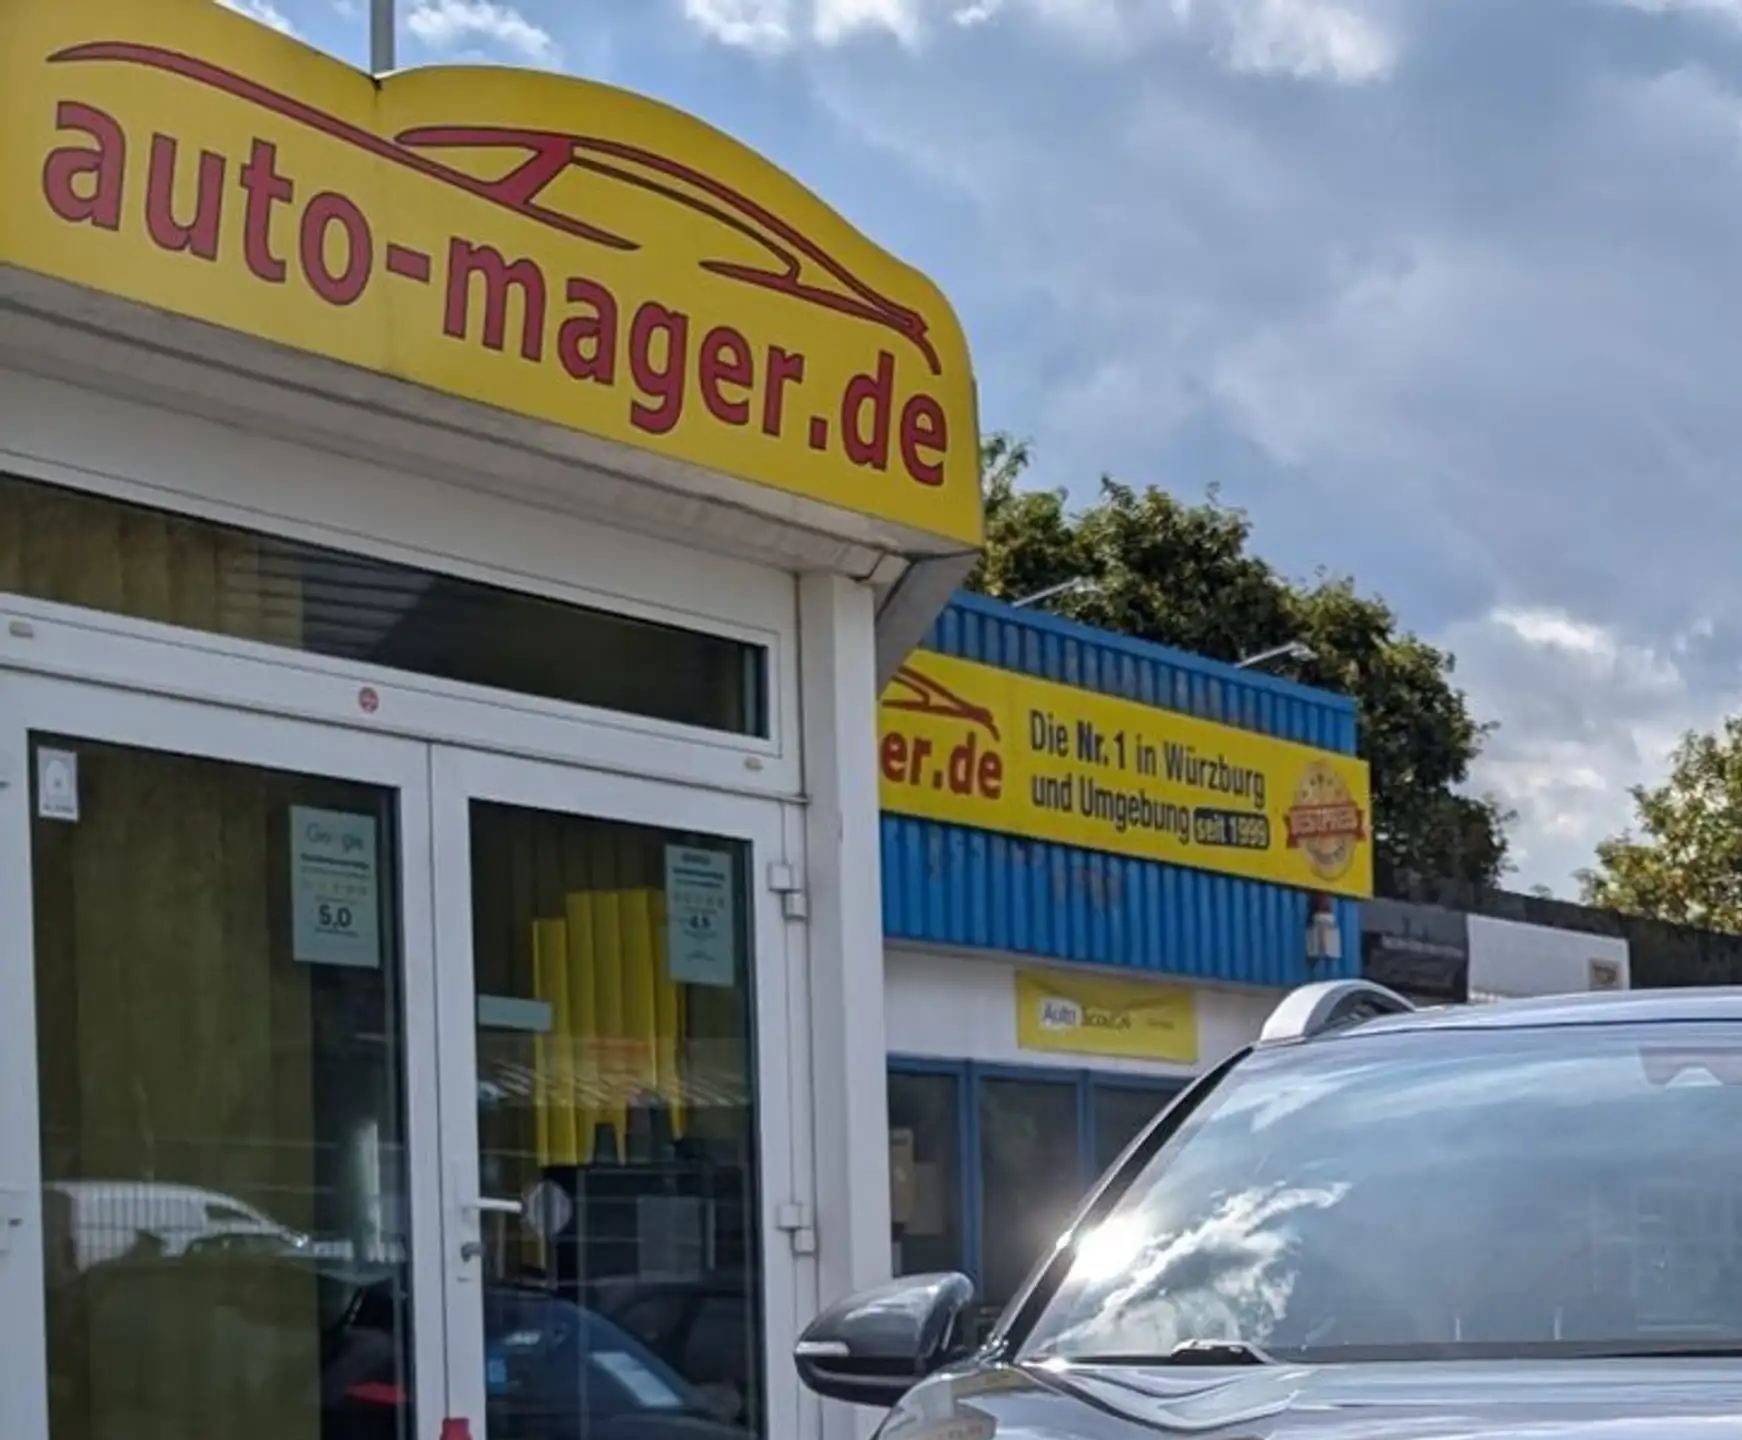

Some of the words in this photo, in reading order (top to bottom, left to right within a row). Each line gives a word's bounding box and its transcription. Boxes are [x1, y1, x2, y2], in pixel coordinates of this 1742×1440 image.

[41, 100, 948, 486] auto-mager.de
[1029, 708, 1069, 757] Die
[1136, 733, 1157, 777] in
[1163, 741, 1265, 810] Würzburg
[1031, 773, 1072, 812] und
[1080, 775, 1190, 845] Umgebung
